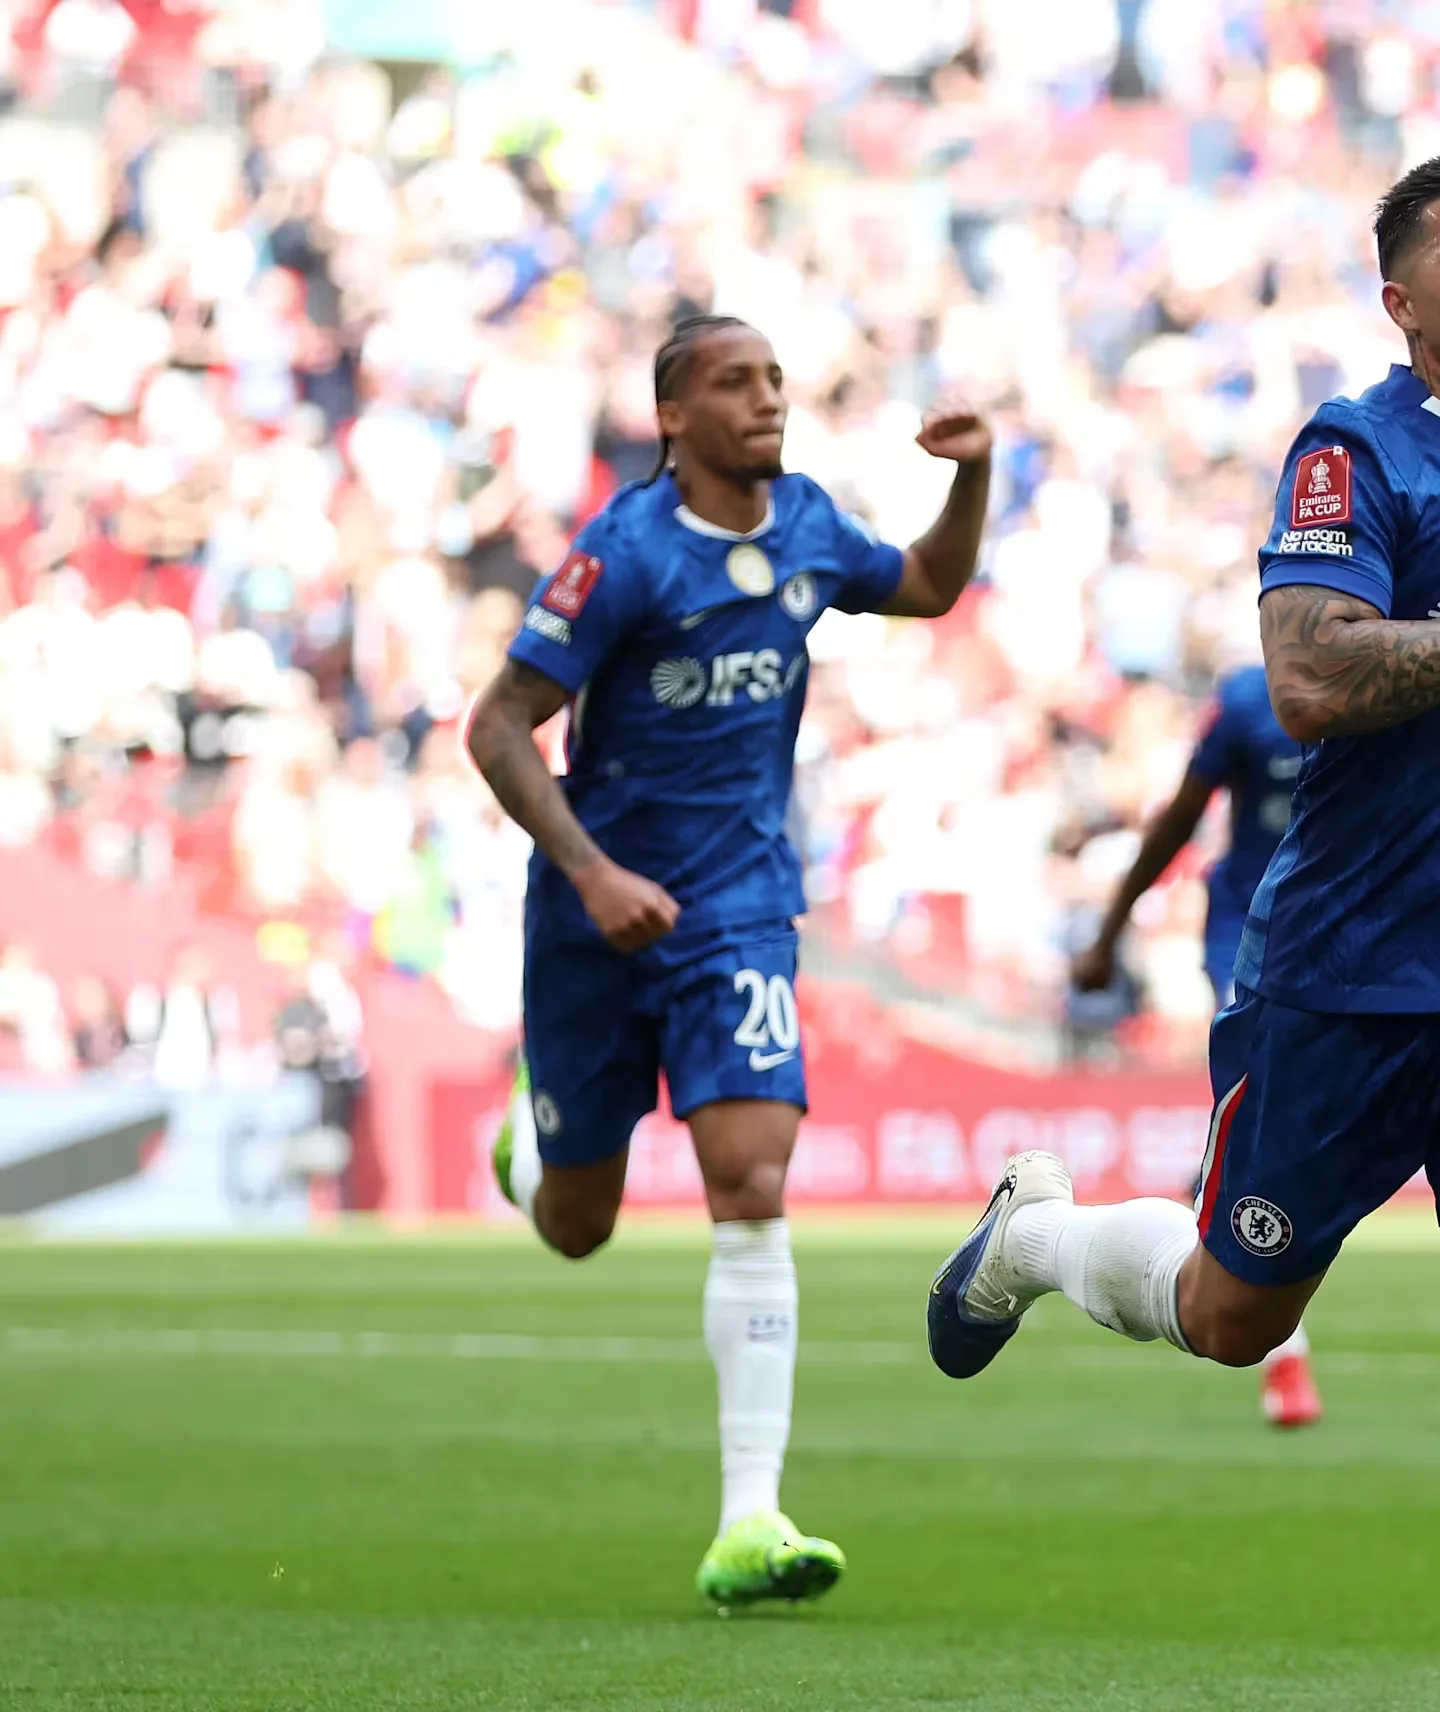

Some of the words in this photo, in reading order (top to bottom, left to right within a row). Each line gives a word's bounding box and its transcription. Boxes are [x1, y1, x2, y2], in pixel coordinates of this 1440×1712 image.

[1299, 494, 1341, 508] Emirates
[1299, 507, 1314, 519] FA
[1315, 503, 1342, 516] CUP
[1281, 530, 1303, 543] No
[1303, 529, 1346, 544] room
[1278, 541, 1301, 554] for
[1301, 540, 1353, 557] racism
[706, 648, 806, 708] IFS.
[733, 968, 800, 1050] 20
[1245, 1199, 1283, 1221] CHELSEA
